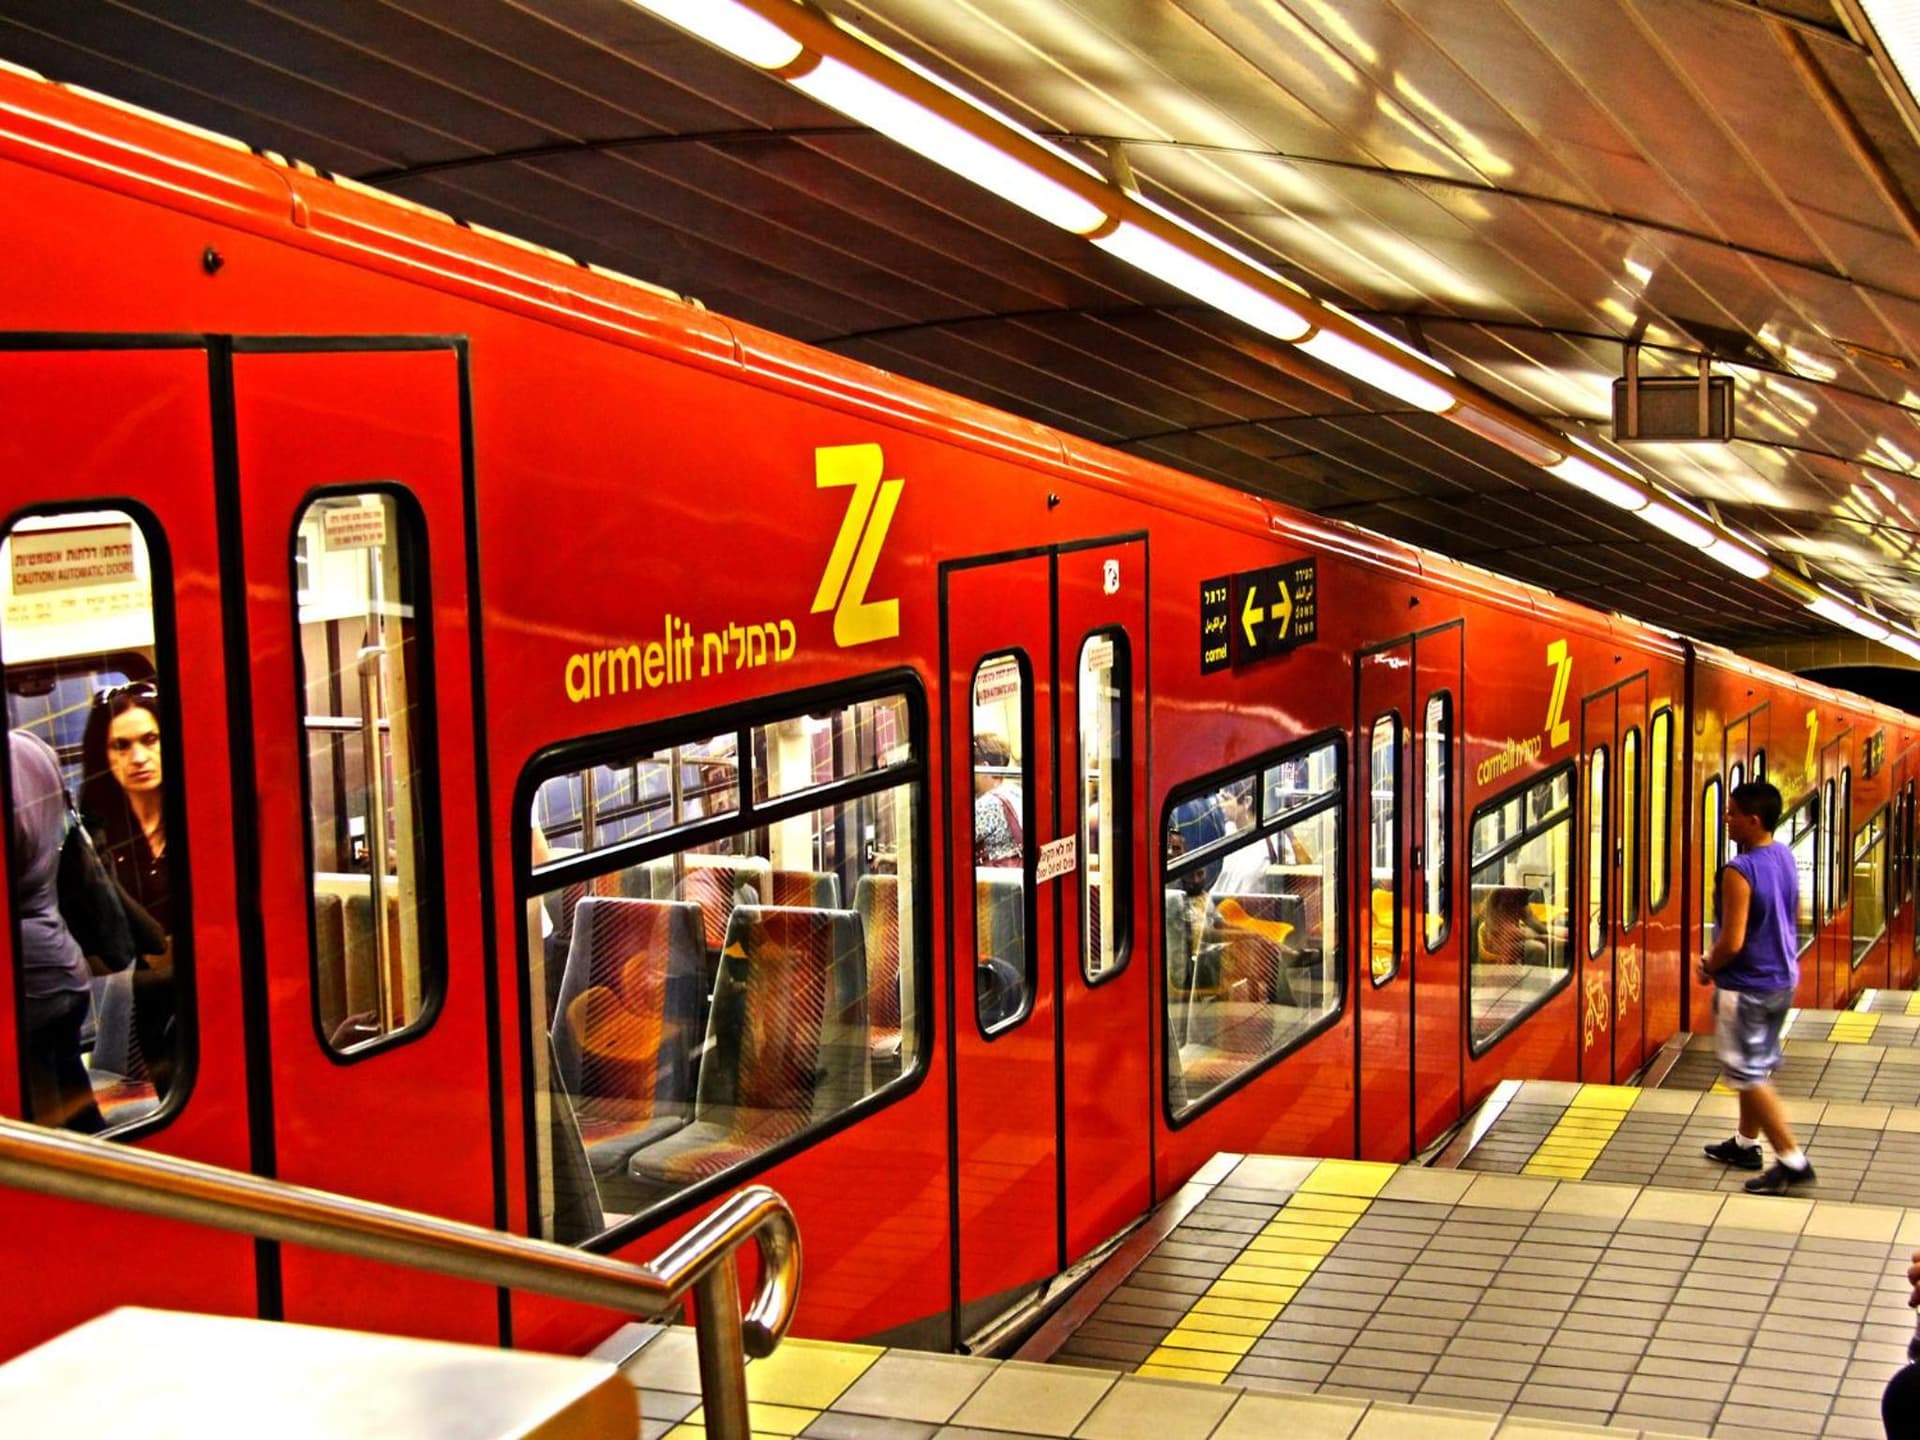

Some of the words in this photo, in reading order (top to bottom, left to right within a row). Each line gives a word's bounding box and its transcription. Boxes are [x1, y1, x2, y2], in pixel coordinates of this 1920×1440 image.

[58, 565, 105, 580] AUTOMATIC
[1204, 588, 1227, 605] כרמל
[565, 613, 694, 703] armelit
[701, 619, 797, 678] כרמלית
[1205, 642, 1227, 663] carmel
